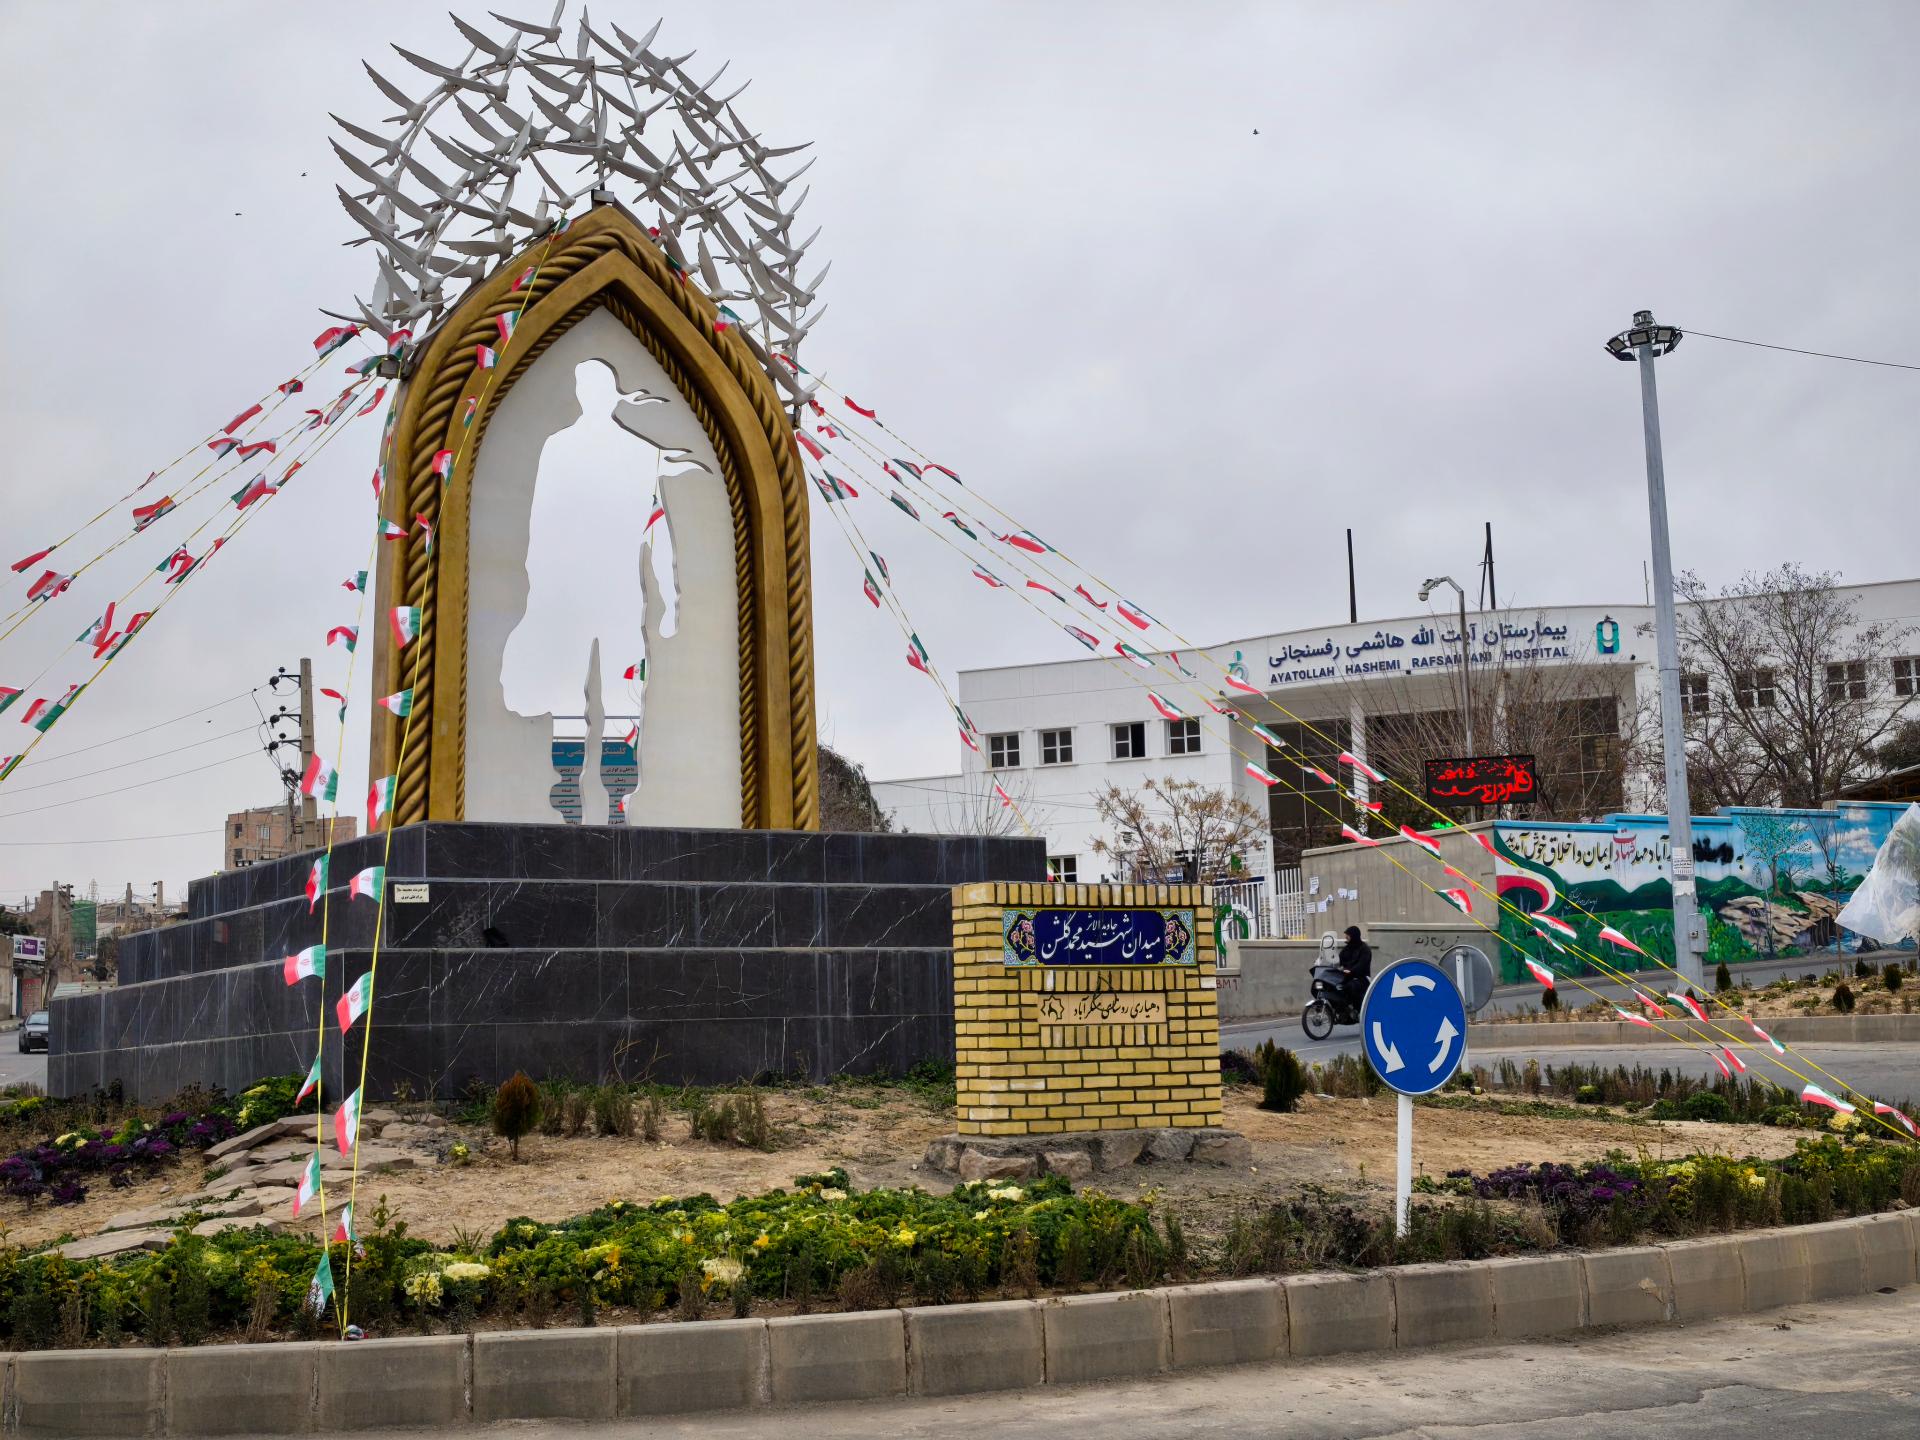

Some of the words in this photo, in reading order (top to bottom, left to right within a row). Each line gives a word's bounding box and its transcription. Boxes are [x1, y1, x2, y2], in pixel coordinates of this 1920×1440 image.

[1346, 631, 1404, 658] هاشمی
[1412, 624, 1434, 645] الله
[1484, 621, 1567, 645] بیمارستان
[1269, 638, 1340, 668] رفسنجانی
[1270, 666, 1335, 684] AYATOLLAH
[1345, 659, 1400, 675] HASHEMI
[1412, 651, 1492, 668] RAFSANANI
[1504, 646, 1568, 661] HOSPITAL
[1505, 831, 1530, 852] آمدید
[1524, 832, 1546, 859] خوش
[1542, 833, 1576, 867] اخلاق
[1613, 828, 1637, 863] شهادت
[1583, 841, 1614, 871] ایمان
[1631, 847, 1648, 865] مهد
[1041, 911, 1077, 959] گلشن
[1064, 927, 1083, 950] محمد
[1076, 913, 1133, 959] شهید
[1122, 931, 1160, 959] میدان
[1130, 999, 1160, 1019] دهیاری
